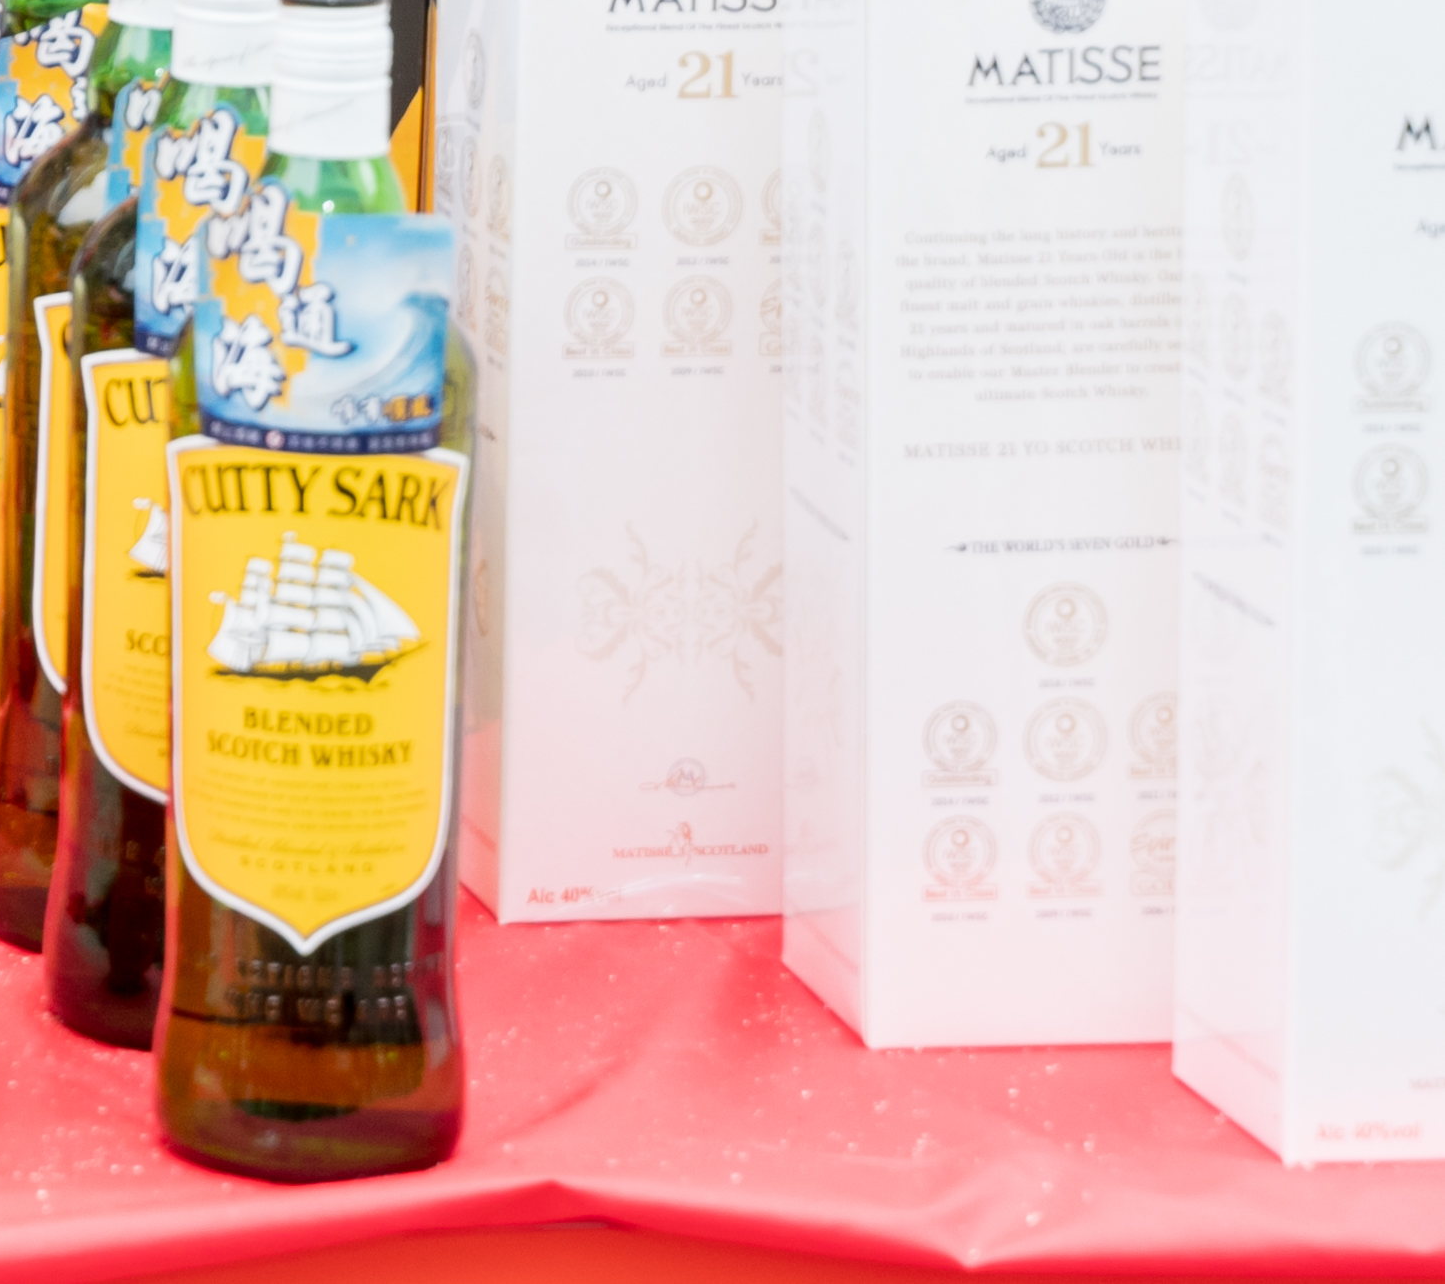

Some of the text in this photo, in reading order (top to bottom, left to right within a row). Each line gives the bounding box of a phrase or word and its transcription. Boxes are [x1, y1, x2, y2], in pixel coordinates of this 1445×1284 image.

[625, 71, 667, 92] Aged
[677, 50, 738, 100] 21
[966, 44, 1162, 87] MATISSE
[985, 120, 1142, 169] Aged 21 Years
[905, 226, 1138, 245] Continuing the long history and
[896, 254, 918, 267] the
[977, 253, 1032, 265] Matisse
[1038, 252, 1052, 263] 21
[1058, 251, 1097, 263] Years
[1102, 250, 1127, 262] Old
[1149, 248, 1172, 261] the
[906, 276, 956, 291] quality
[980, 274, 1037, 287] blended
[1045, 273, 1090, 286] Scotch
[900, 299, 941, 312] finest
[946, 298, 978, 311] malt
[984, 298, 1010, 310] and
[1017, 297, 1053, 312] grain
[909, 323, 924, 334] 21
[930, 324, 968, 337] years
[974, 322, 999, 334] and
[1006, 319, 1065, 333] matured
[1089, 318, 1114, 330] oak
[1119, 317, 1170, 330] barrels
[900, 344, 975, 361] Highlands
[1072, 343, 1094, 354] are
[1099, 340, 1162, 355] carefully
[928, 367, 975, 379] enable
[980, 368, 1004, 379] our
[1010, 365, 1059, 378] Master
[1066, 363, 1121, 376] Blender
[975, 389, 1035, 402] ultimate
[1041, 386, 1088, 400] Scotch
[903, 442, 990, 459] MATISSE
[997, 441, 1016, 455] 21
[1022, 440, 1049, 455] YO
[1055, 437, 1134, 454] SCOTCH
[181, 462, 451, 530] CUTTY SARK
[972, 541, 998, 553] THE
[1068, 538, 1110, 551] SEVEN
[1115, 536, 1155, 549] GOLD
[243, 706, 375, 736] BLENDED
[207, 728, 412, 768] SCOTCH WHISKY
[693, 843, 769, 855] SCOTLAND
[239, 855, 375, 874] SCOTLAND
[527, 887, 554, 904] Alc
